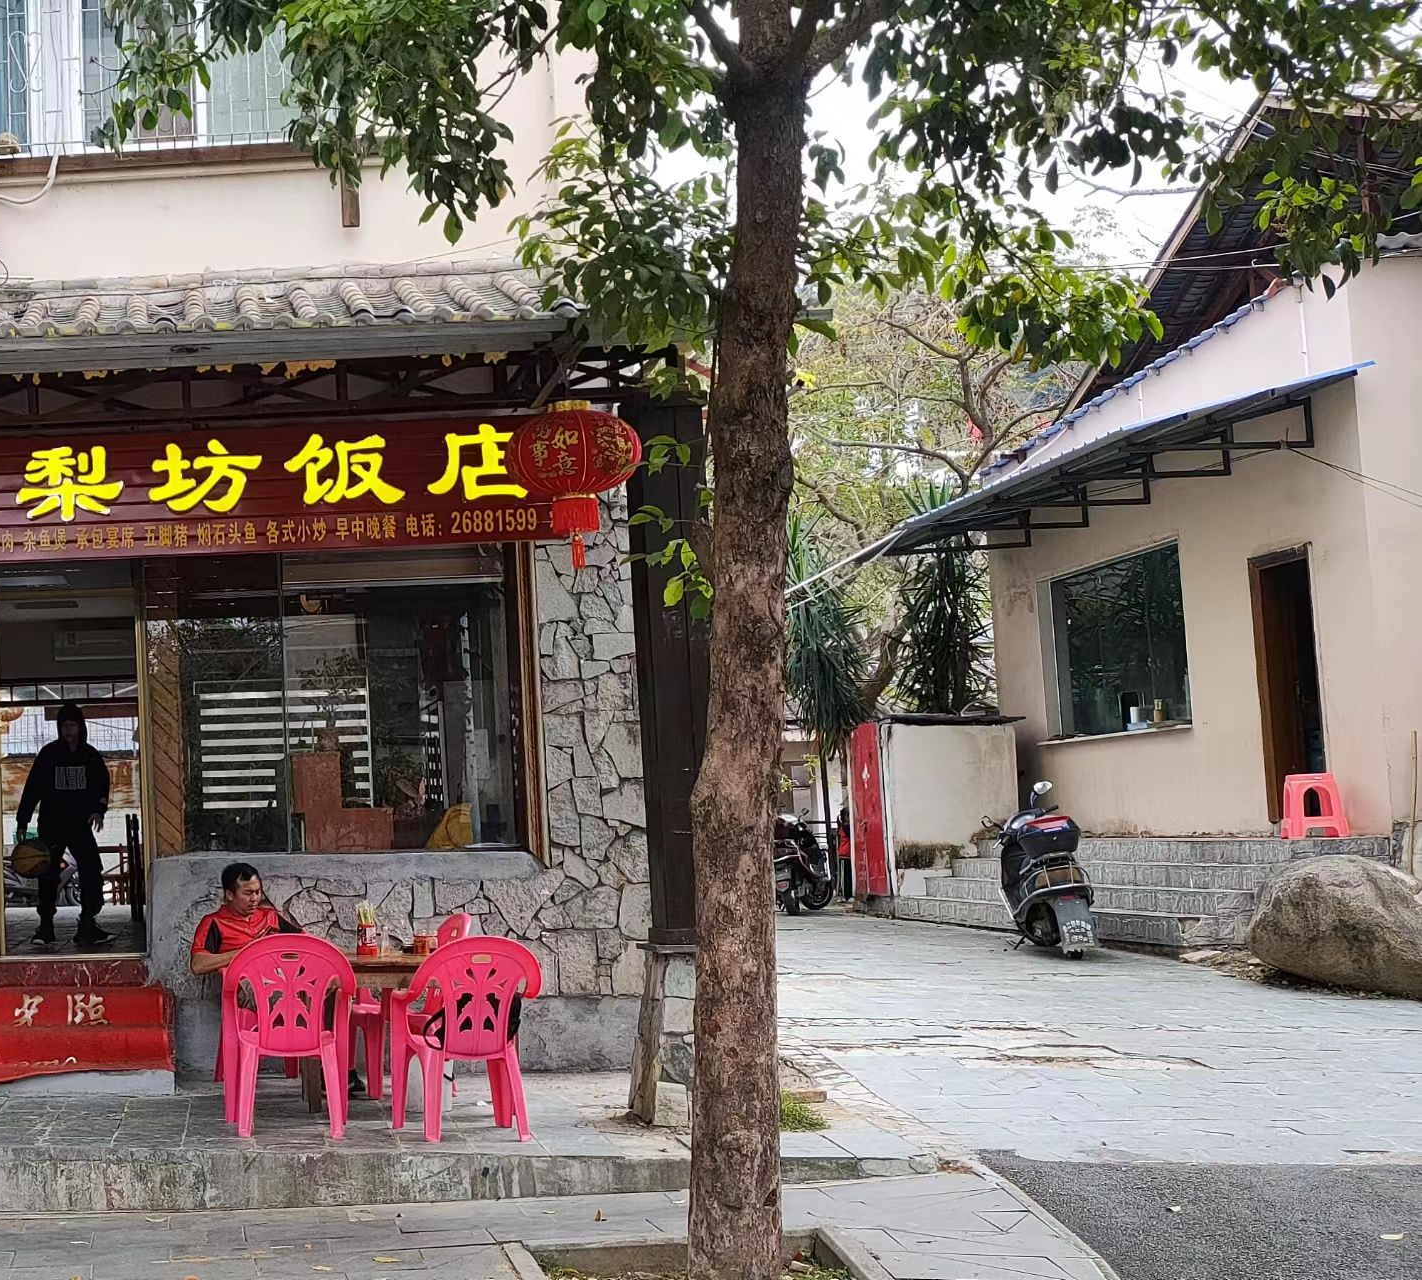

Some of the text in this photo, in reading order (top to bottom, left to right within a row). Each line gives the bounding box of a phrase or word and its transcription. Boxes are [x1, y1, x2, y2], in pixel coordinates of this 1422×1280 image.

[23, 528, 67, 552] 杂鱼煲
[75, 526, 136, 551] 承包宴席
[144, 523, 189, 548] 五脚猪
[196, 520, 258, 546] 焖石头鱼
[266, 517, 327, 545] 各式小炒
[335, 514, 397, 541] 早中晚餐
[450, 507, 538, 534] 26881599
